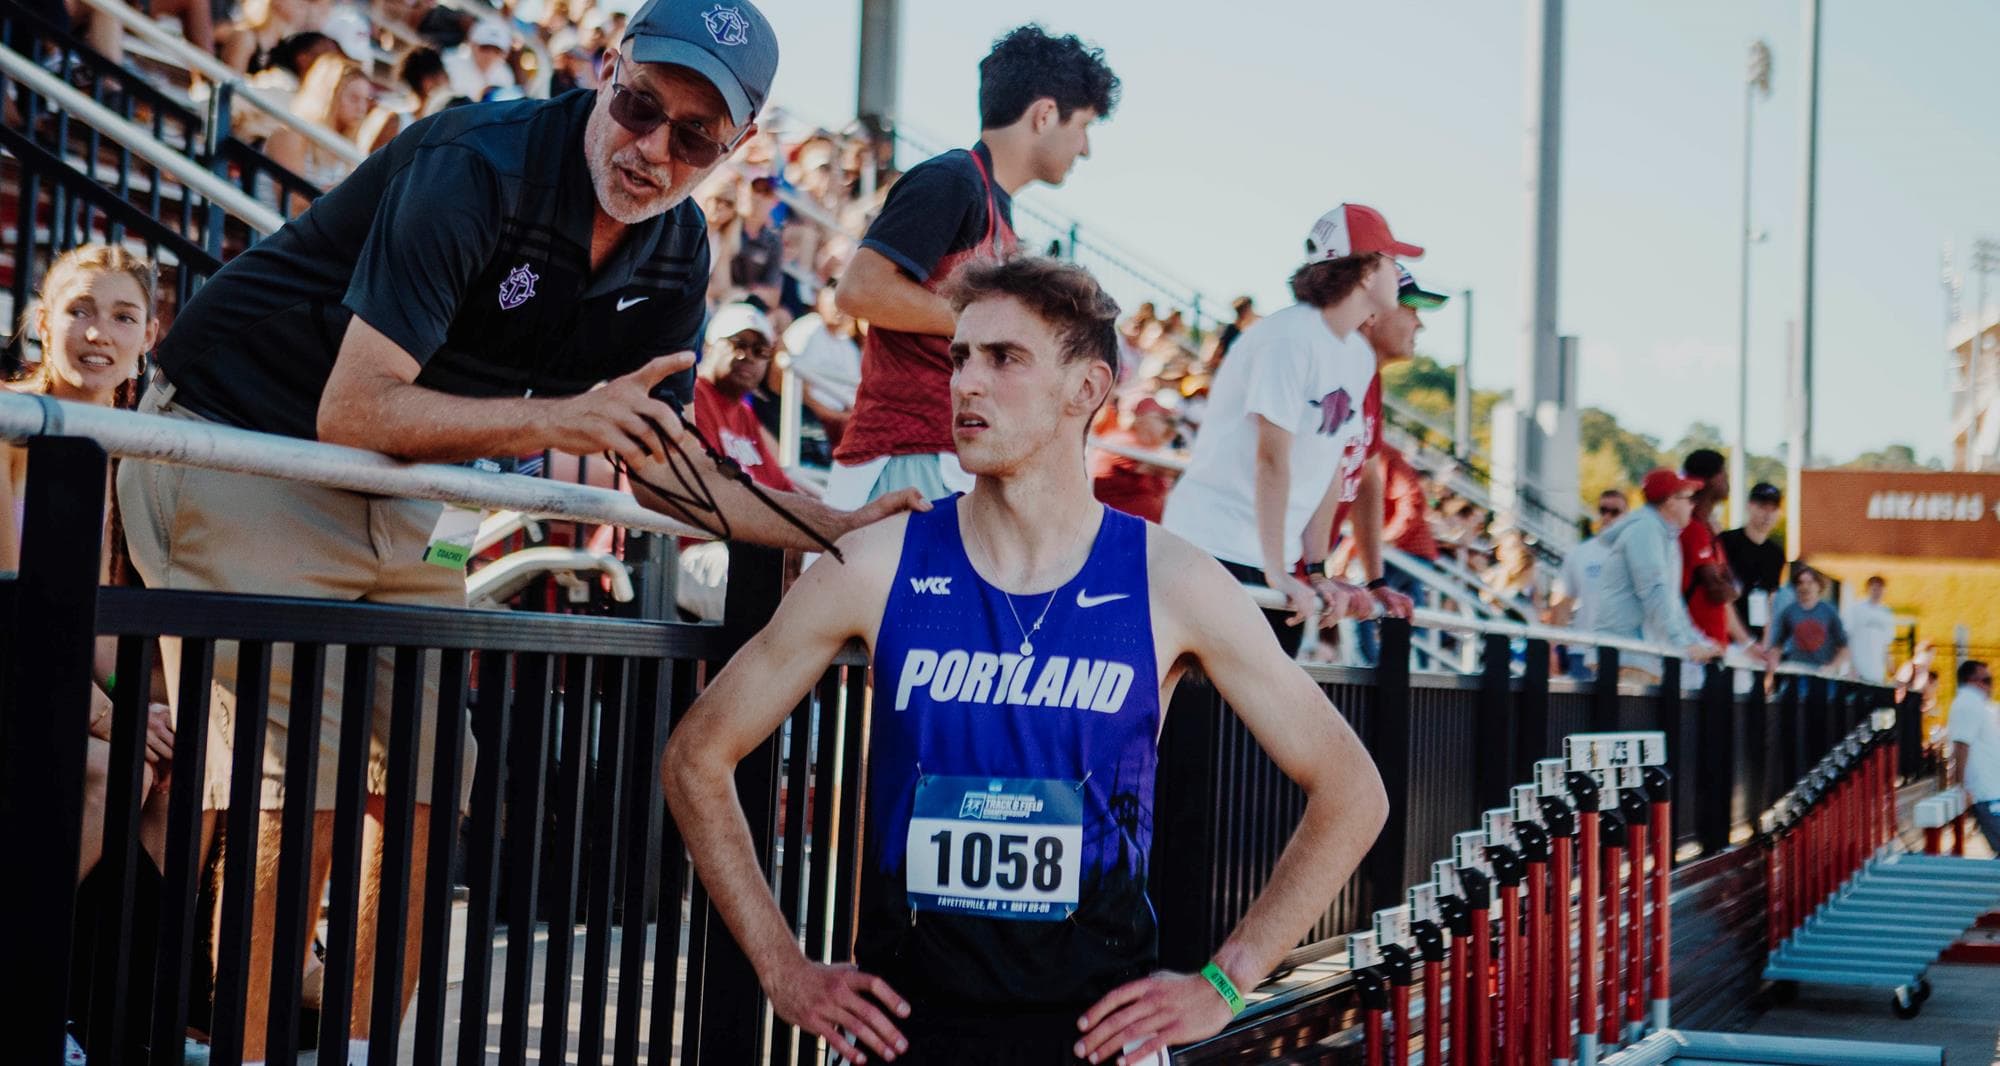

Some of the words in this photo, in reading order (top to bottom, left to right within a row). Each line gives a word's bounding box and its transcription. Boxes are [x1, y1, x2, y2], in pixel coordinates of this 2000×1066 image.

[910, 576, 952, 595] WCC
[895, 649, 1135, 714] PORTLAND
[1020, 800, 1044, 812] FIELD
[930, 830, 1063, 892] 1058
[986, 900, 998, 911] AR
[1210, 972, 1239, 1005] ATHLETE
